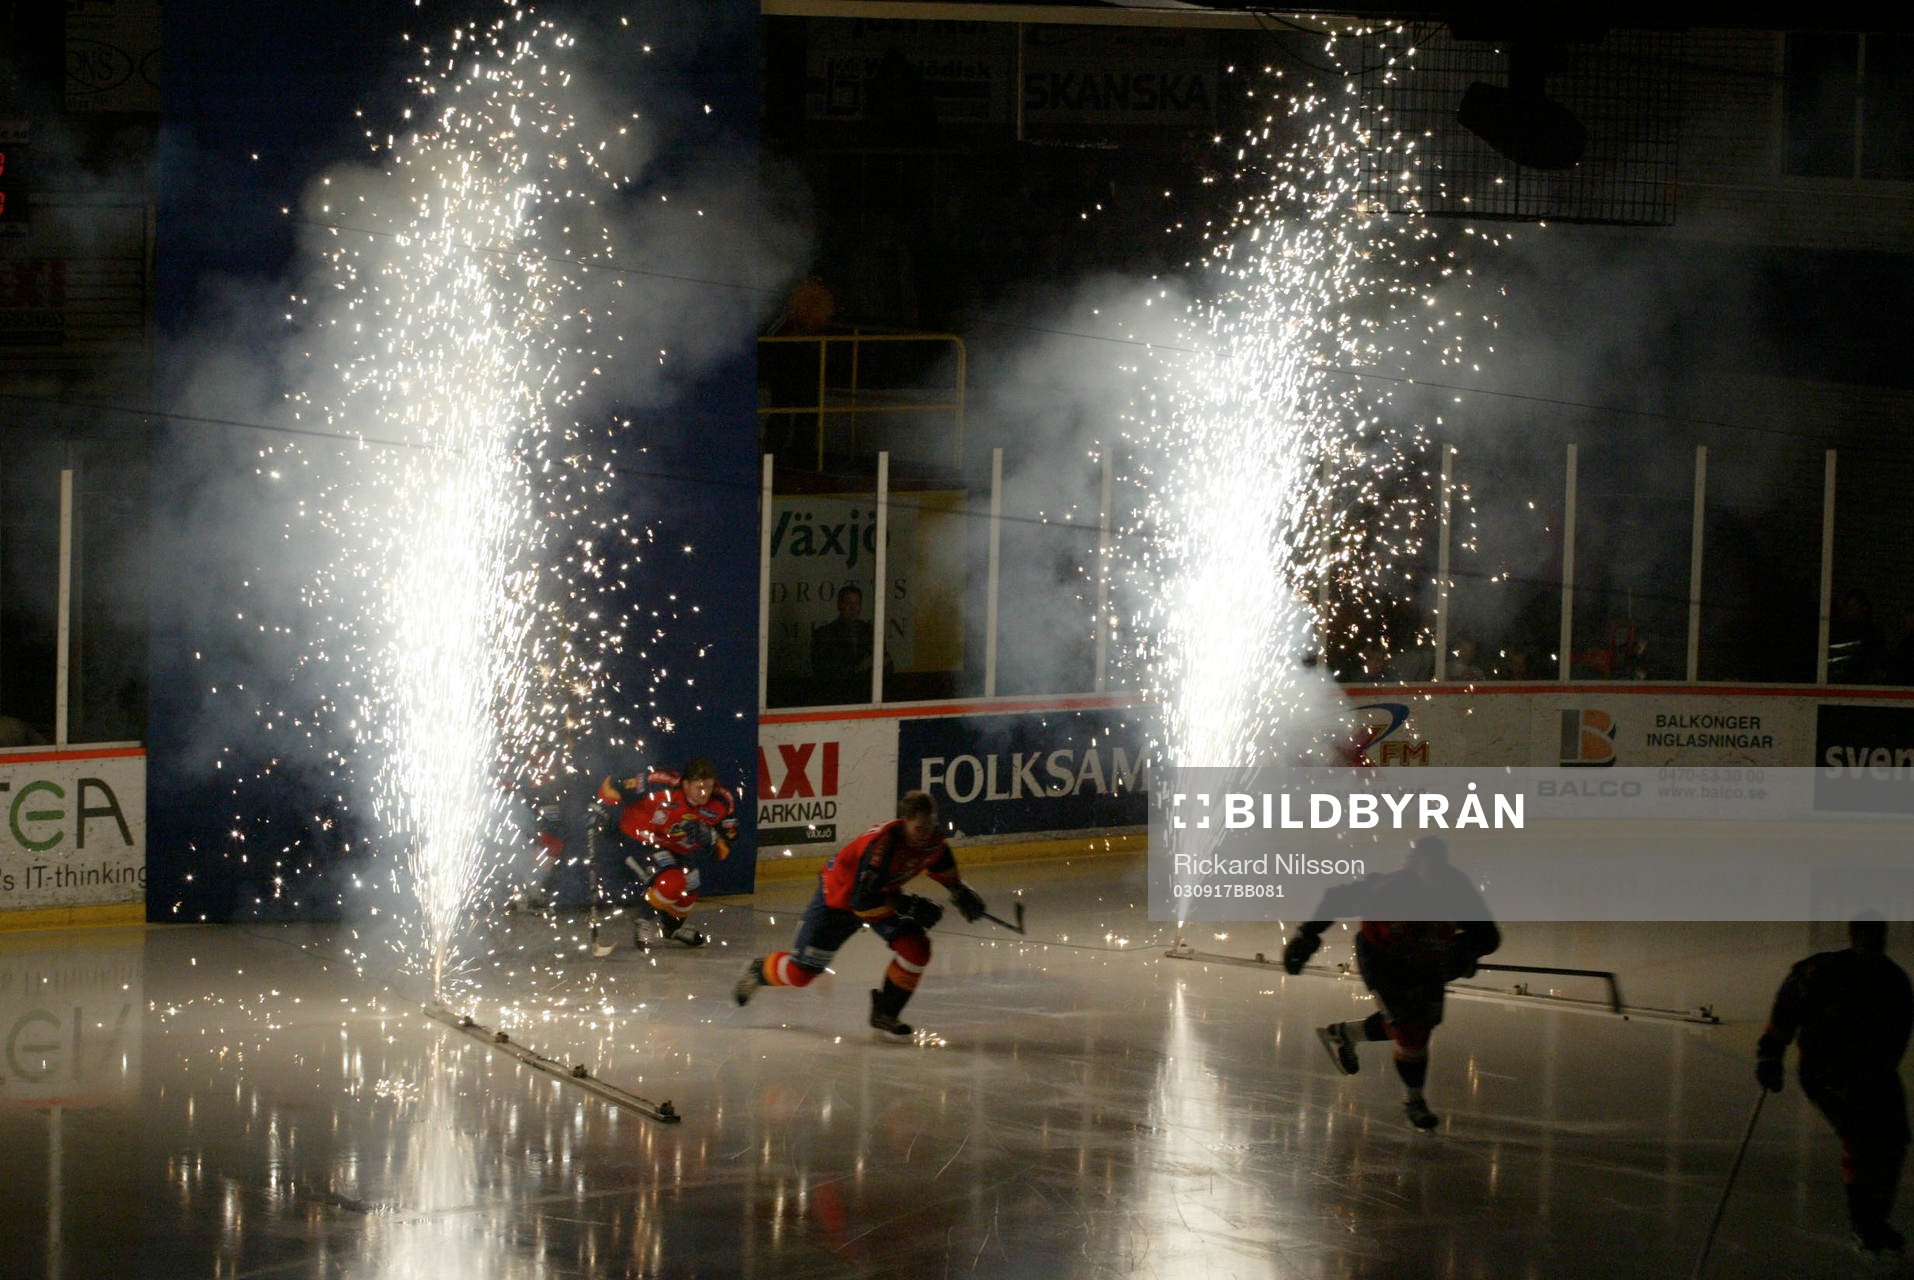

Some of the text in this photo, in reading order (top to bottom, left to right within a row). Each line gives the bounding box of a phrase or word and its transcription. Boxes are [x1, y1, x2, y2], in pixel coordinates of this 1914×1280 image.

[1025, 72, 1212, 111] SKANSKA
[1655, 714, 1761, 731] BALKONGER
[1646, 733, 1773, 750] INGLASNINGAR
[1379, 740, 1430, 767] FM
[920, 745, 1152, 803] FOLKSAM
[1537, 780, 1642, 800] BALCO
[1657, 785, 1768, 800] www.balco.se
[758, 801, 837, 825] ARKNAD
